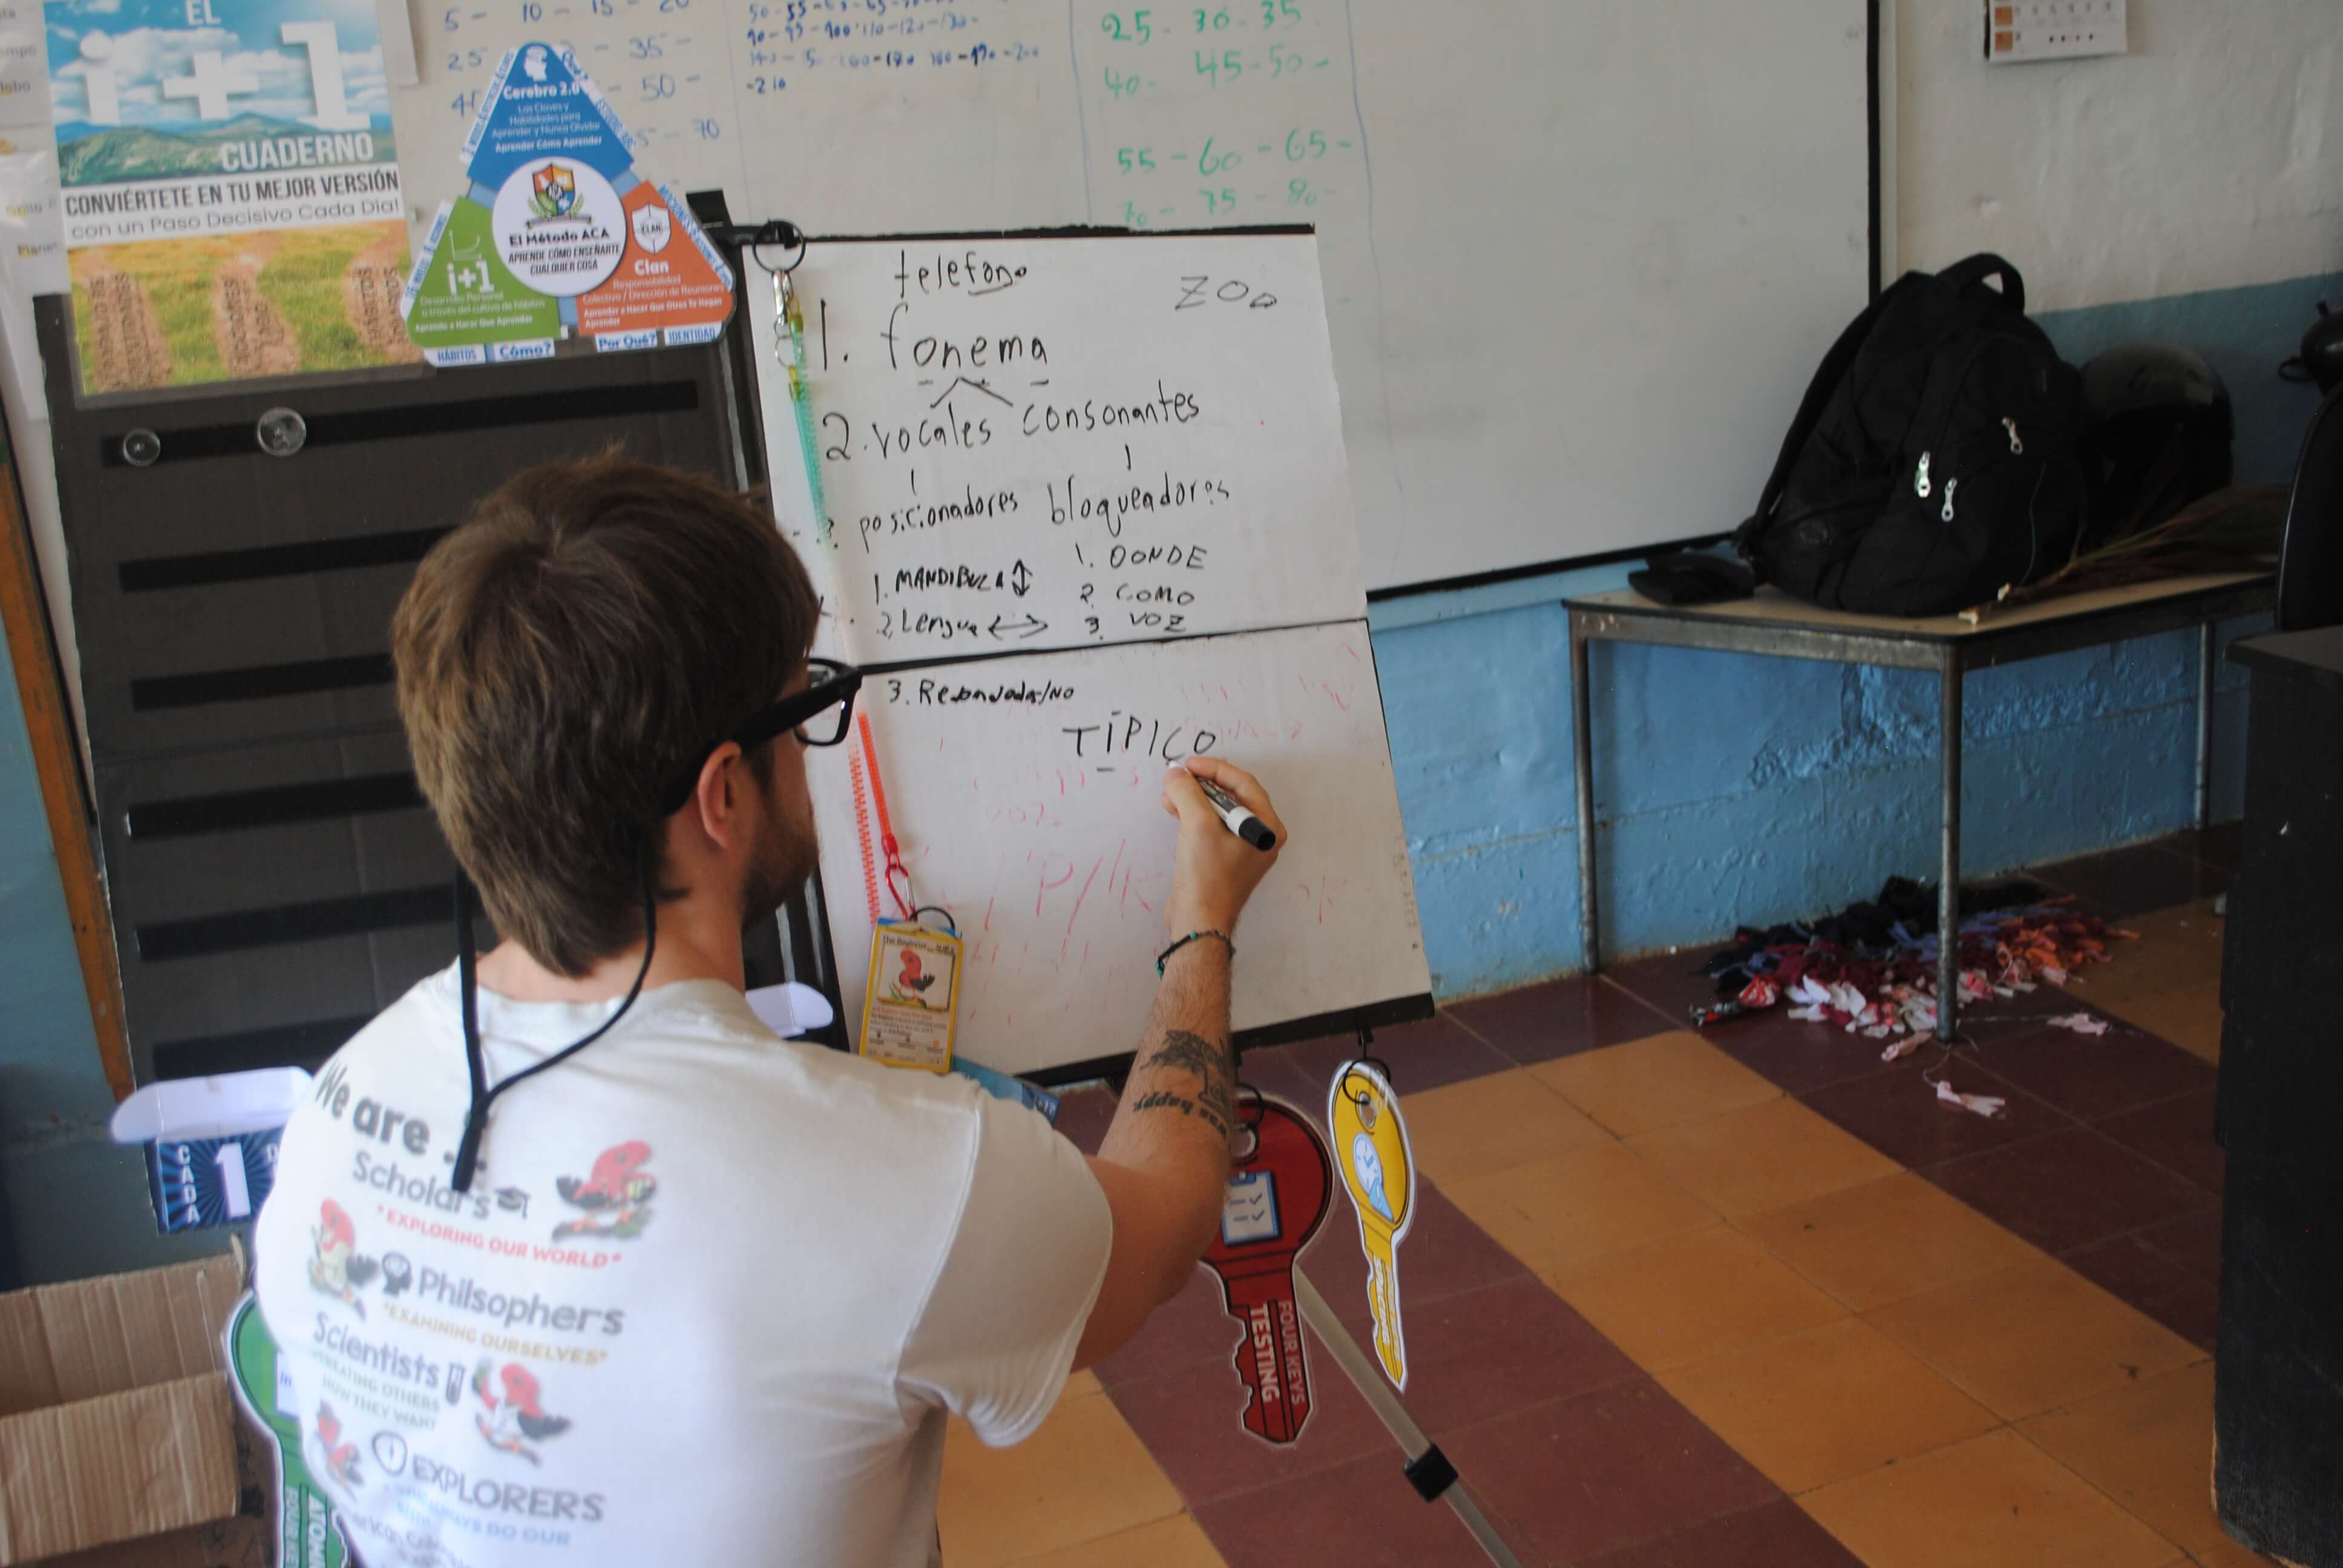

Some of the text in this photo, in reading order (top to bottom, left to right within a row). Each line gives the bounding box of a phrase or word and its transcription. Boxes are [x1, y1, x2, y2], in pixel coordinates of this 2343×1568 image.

[186, 0, 221, 25] EL
[444, 7, 459, 31] 5
[522, 2, 543, 23] 10
[1100, 0, 1302, 45] 25 30 35
[629, 36, 663, 59] 35
[502, 80, 581, 101] Cerebro 2.0
[640, 74, 677, 102] 50
[1104, 65, 1141, 100] 40
[1194, 50, 1244, 88] 45
[220, 131, 375, 172] CUADERNO
[495, 141, 536, 154] Aprender
[563, 134, 603, 149] Aprender
[1117, 127, 1328, 176] 55 60 65
[65, 184, 193, 217] CONVIÉRTETE
[197, 184, 223, 206] EN
[226, 181, 252, 203] TU
[256, 177, 316, 201] MEJOR
[319, 169, 400, 195] VERSIÓN
[71, 223, 113, 240] con
[119, 221, 145, 237] un
[151, 215, 202, 235] Paso
[208, 204, 293, 230] Decisivo
[298, 201, 356, 221] Cada
[509, 226, 609, 247] El Método ACA
[508, 250, 546, 264] APRENDE
[574, 242, 621, 258] ENSEÑARTE
[529, 258, 598, 277] CUALQUIER COSA
[634, 258, 669, 276] Clan
[446, 260, 495, 296] i+1
[583, 307, 621, 320] Aprender
[585, 316, 621, 330] Aprender
[499, 341, 552, 360] Cómo?
[598, 333, 657, 350] Por Qué?
[668, 327, 716, 344] IDENTIDAD
[819, 298, 1049, 371] 1. fonema
[1023, 377, 1201, 437] consonantes
[859, 469, 1231, 554] posicionadores bloqueadores
[1115, 582, 1196, 606] COMO
[886, 678, 910, 706] 3.
[1062, 710, 1216, 762] TÍPICO
[315, 1058, 431, 1156] We are
[214, 1142, 252, 1220] 1
[352, 1149, 491, 1221] Scholars
[488, 1236, 528, 1259] OUR
[418, 1263, 626, 1338] Philsophers
[313, 1310, 441, 1389] Scientists
[1249, 1302, 1280, 1403] TESTING
[1277, 1299, 1306, 1406] FOUR KEYS
[411, 1453, 607, 1523] EXPLORERS
